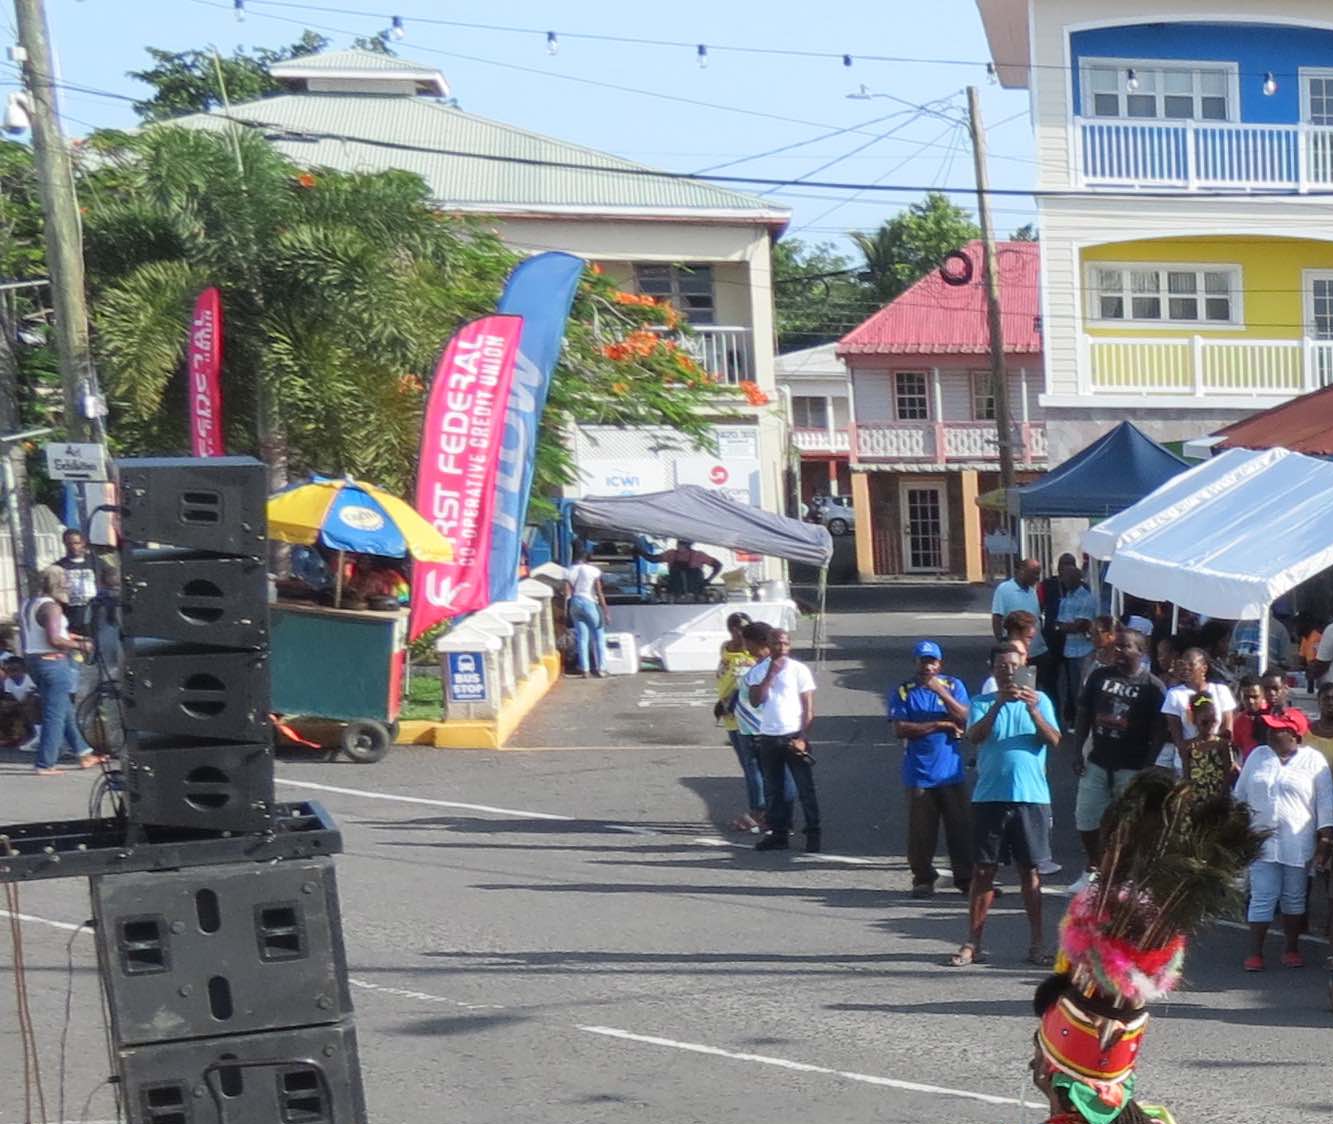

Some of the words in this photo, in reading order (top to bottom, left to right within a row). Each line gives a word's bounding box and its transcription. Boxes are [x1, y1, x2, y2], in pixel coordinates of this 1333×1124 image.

[486, 335, 506, 387] UNION
[437, 333, 486, 475] FEDERAL
[469, 391, 495, 453] CREDIT
[456, 460, 487, 567] CO-OPERATIVE
[452, 684, 484, 694] STOP
[454, 673, 481, 684] BUS
[1102, 679, 1140, 698] LRG
